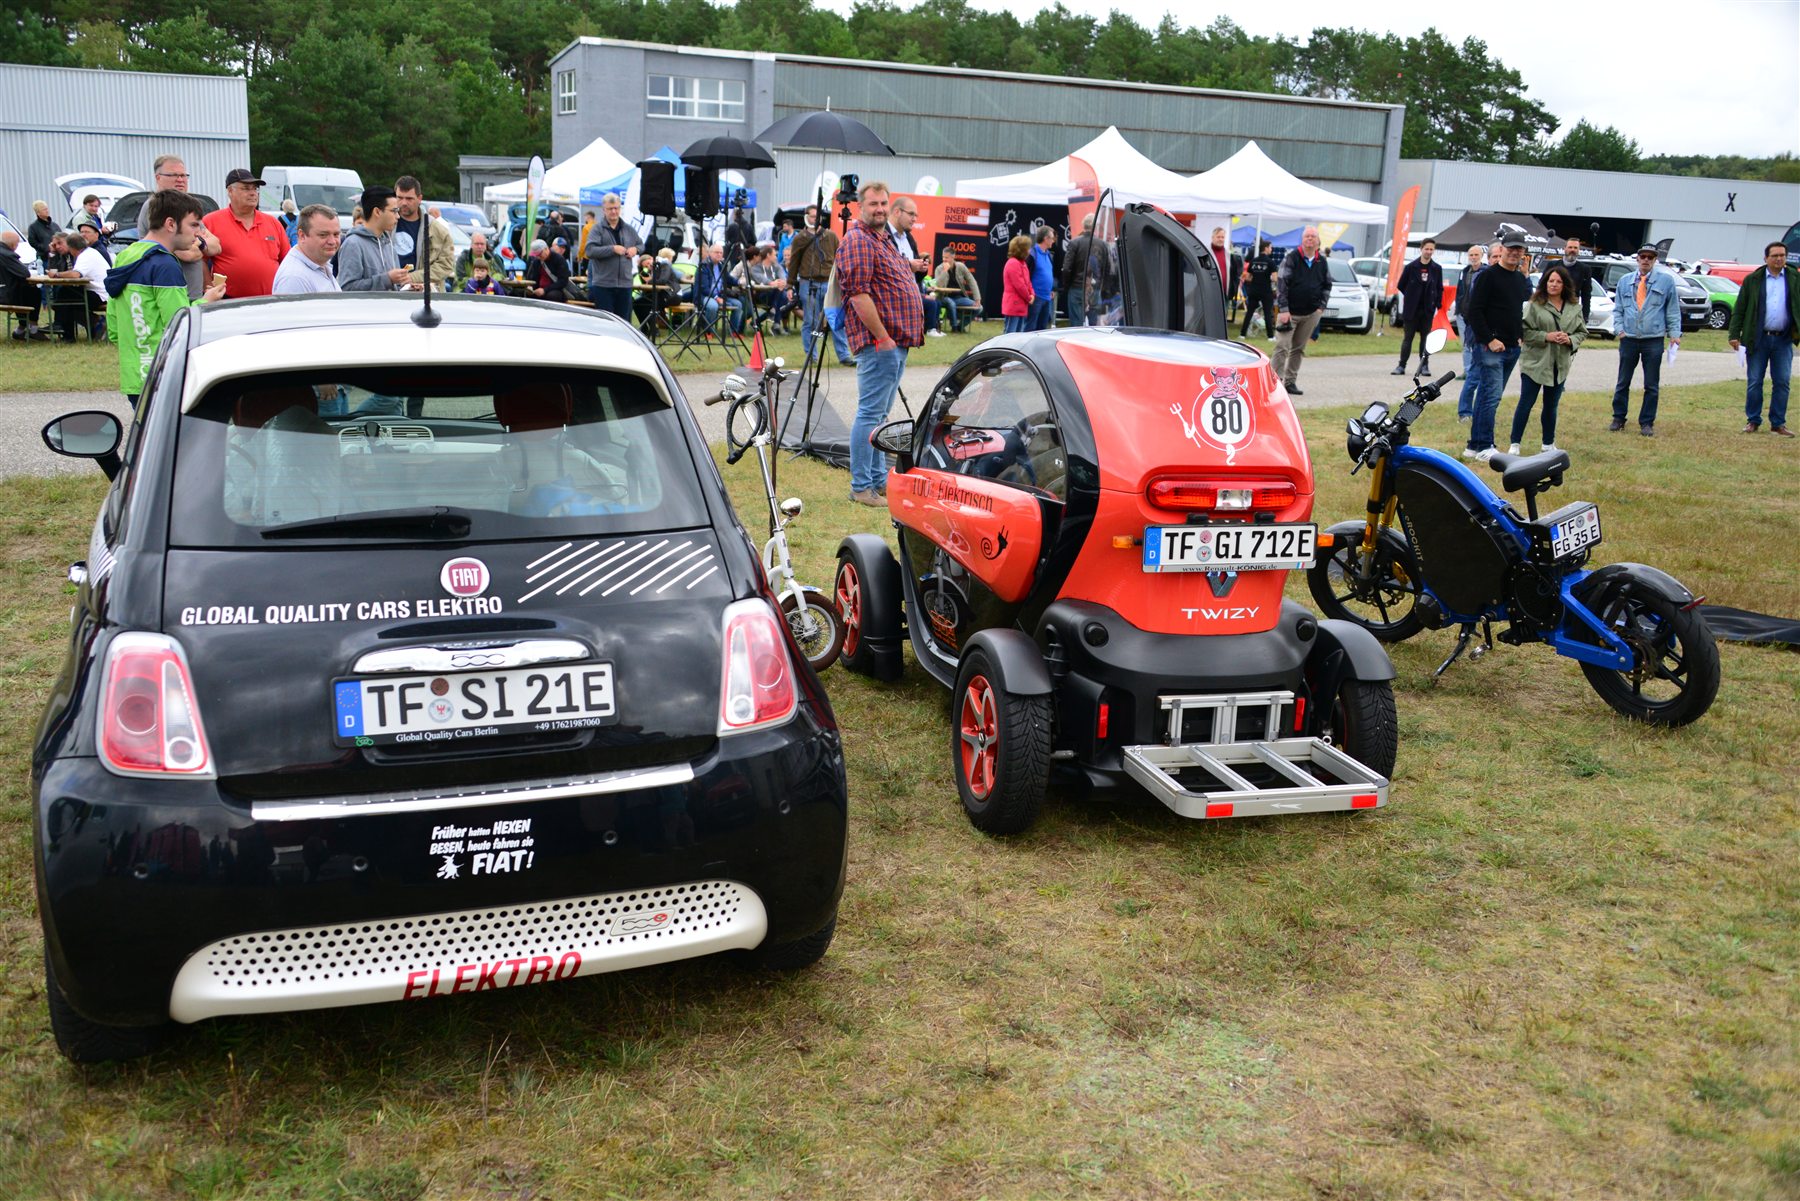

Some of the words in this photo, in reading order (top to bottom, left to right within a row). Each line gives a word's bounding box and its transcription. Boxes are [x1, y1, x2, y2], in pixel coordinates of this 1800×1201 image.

[945, 206, 980, 216] ENERGIE
[1725, 192, 1737, 212] X
[944, 214, 967, 223] INSEL
[1211, 399, 1243, 435] 80
[938, 479, 993, 513] Elektrisch
[1560, 519, 1576, 537] TF
[1165, 532, 1196, 560] TF
[1215, 531, 1242, 559] GI
[1250, 529, 1312, 558] 712E
[1554, 537, 1571, 557] FG
[1574, 529, 1588, 548] 35
[1590, 525, 1599, 540] E
[452, 568, 479, 587] FIAT
[181, 606, 259, 625] GLOBAL
[265, 603, 352, 625] QUALITY
[357, 600, 411, 620] CARS
[416, 596, 503, 617] ELEKTRO
[1181, 606, 1260, 620] TWIZY
[367, 682, 426, 728] TF
[461, 676, 515, 721] SI
[525, 670, 611, 716] 21E
[345, 715, 355, 728] D
[535, 721, 550, 730] +49
[551, 717, 601, 730] 17621987060
[396, 733, 423, 743] Global
[424, 730, 454, 742] Quality
[455, 729, 473, 738] Cars
[474, 726, 499, 736] Berlin
[431, 824, 468, 840] Früher
[468, 827, 491, 837] hatten
[492, 818, 532, 836] HEXEN
[429, 840, 465, 856] BESEN,
[467, 840, 492, 852] heute
[492, 837, 520, 850] fahren
[520, 835, 534, 848] sie
[472, 849, 535, 875] FIAT!
[402, 951, 582, 1000] ELEKTRO
